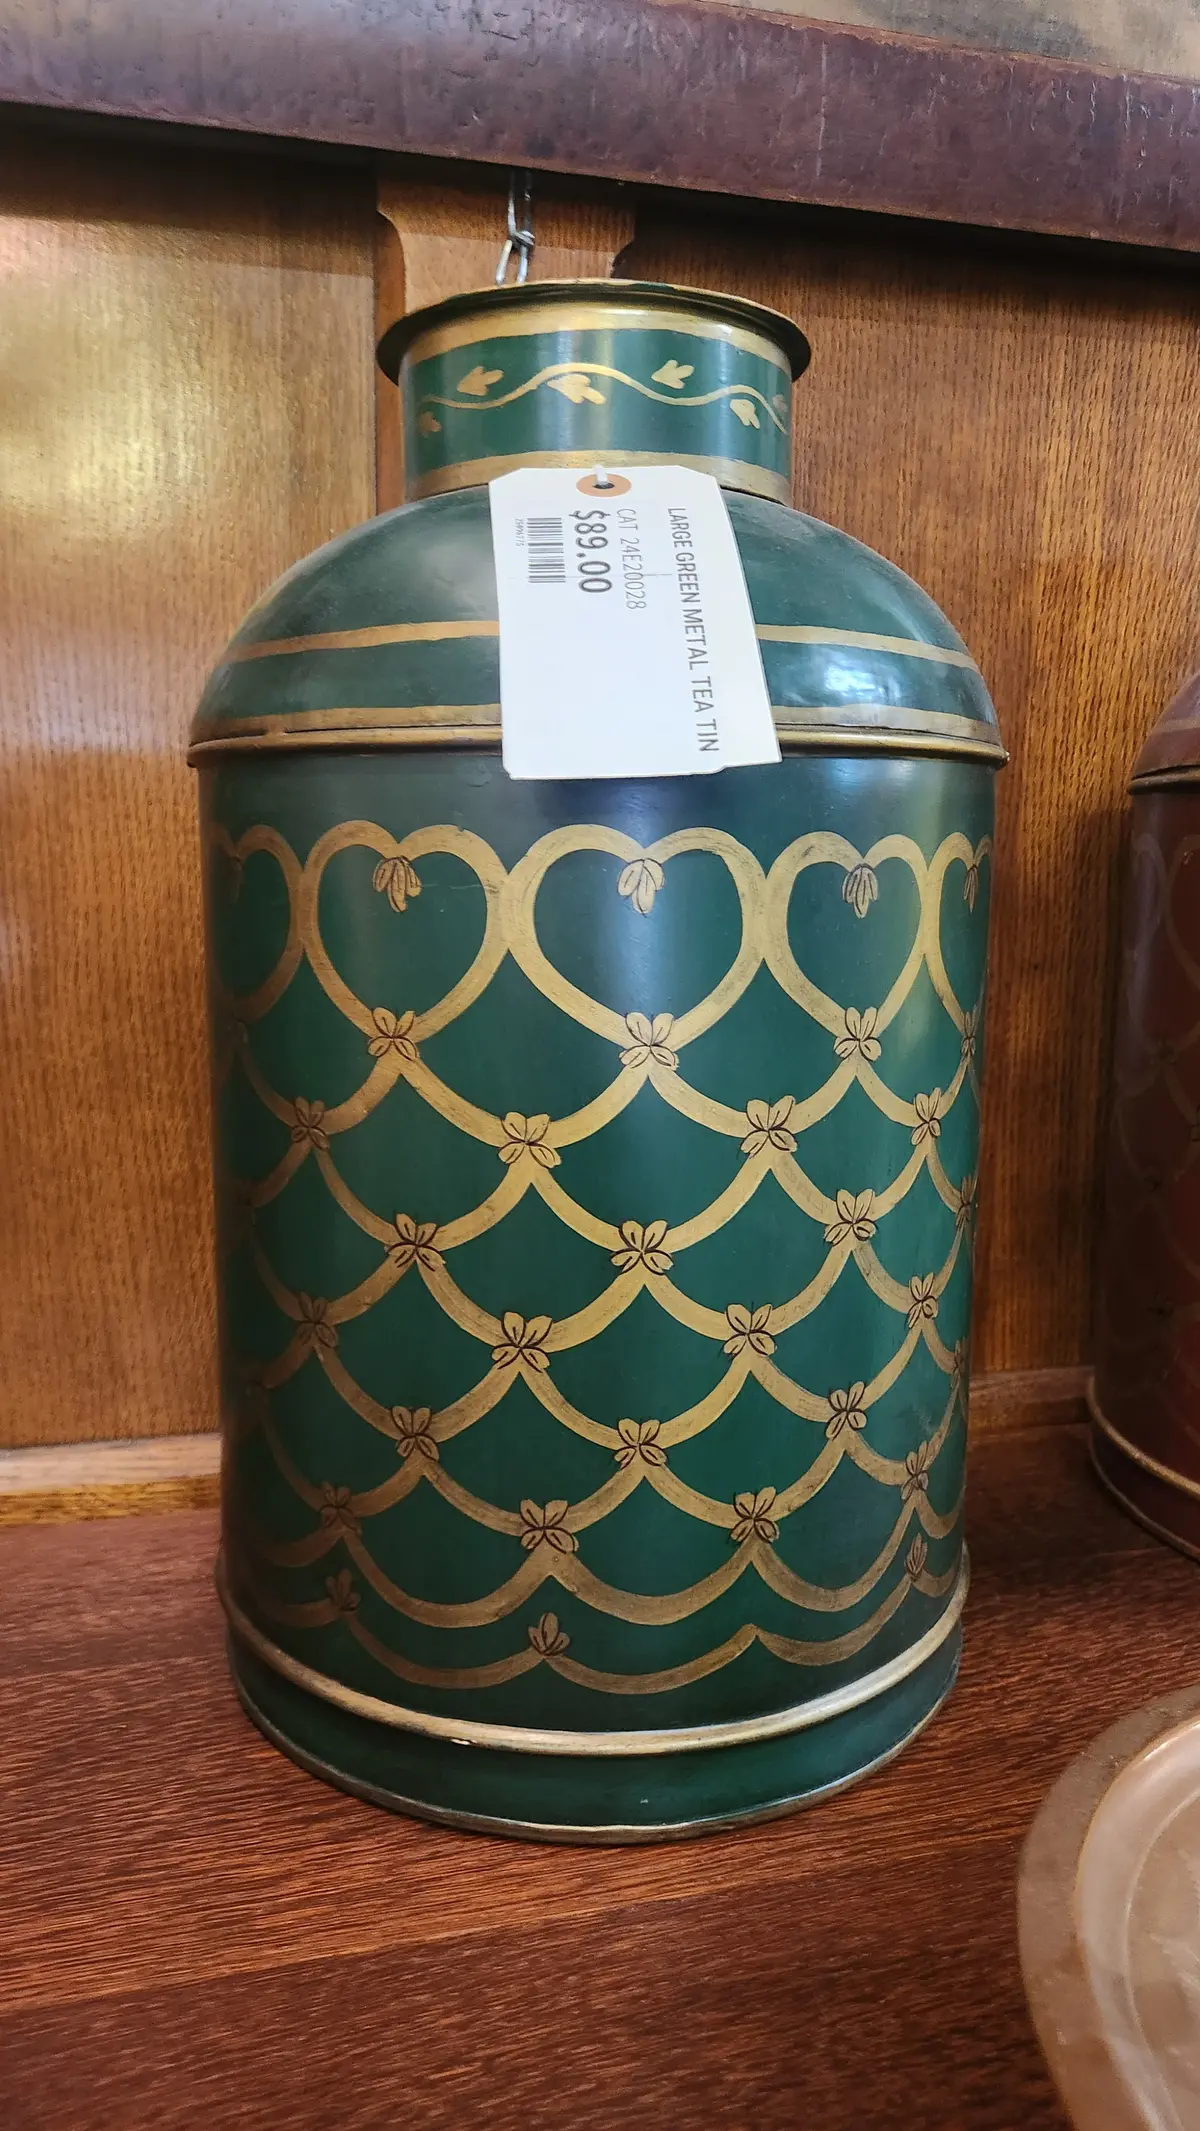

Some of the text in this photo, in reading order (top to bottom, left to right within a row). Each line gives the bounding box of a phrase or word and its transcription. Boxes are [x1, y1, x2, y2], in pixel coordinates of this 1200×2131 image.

[568, 509, 613, 593] $89.00
[616, 508, 647, 610] CAT 24E20028
[667, 507, 720, 752] LARGE GREEN METAL TEA TIN
